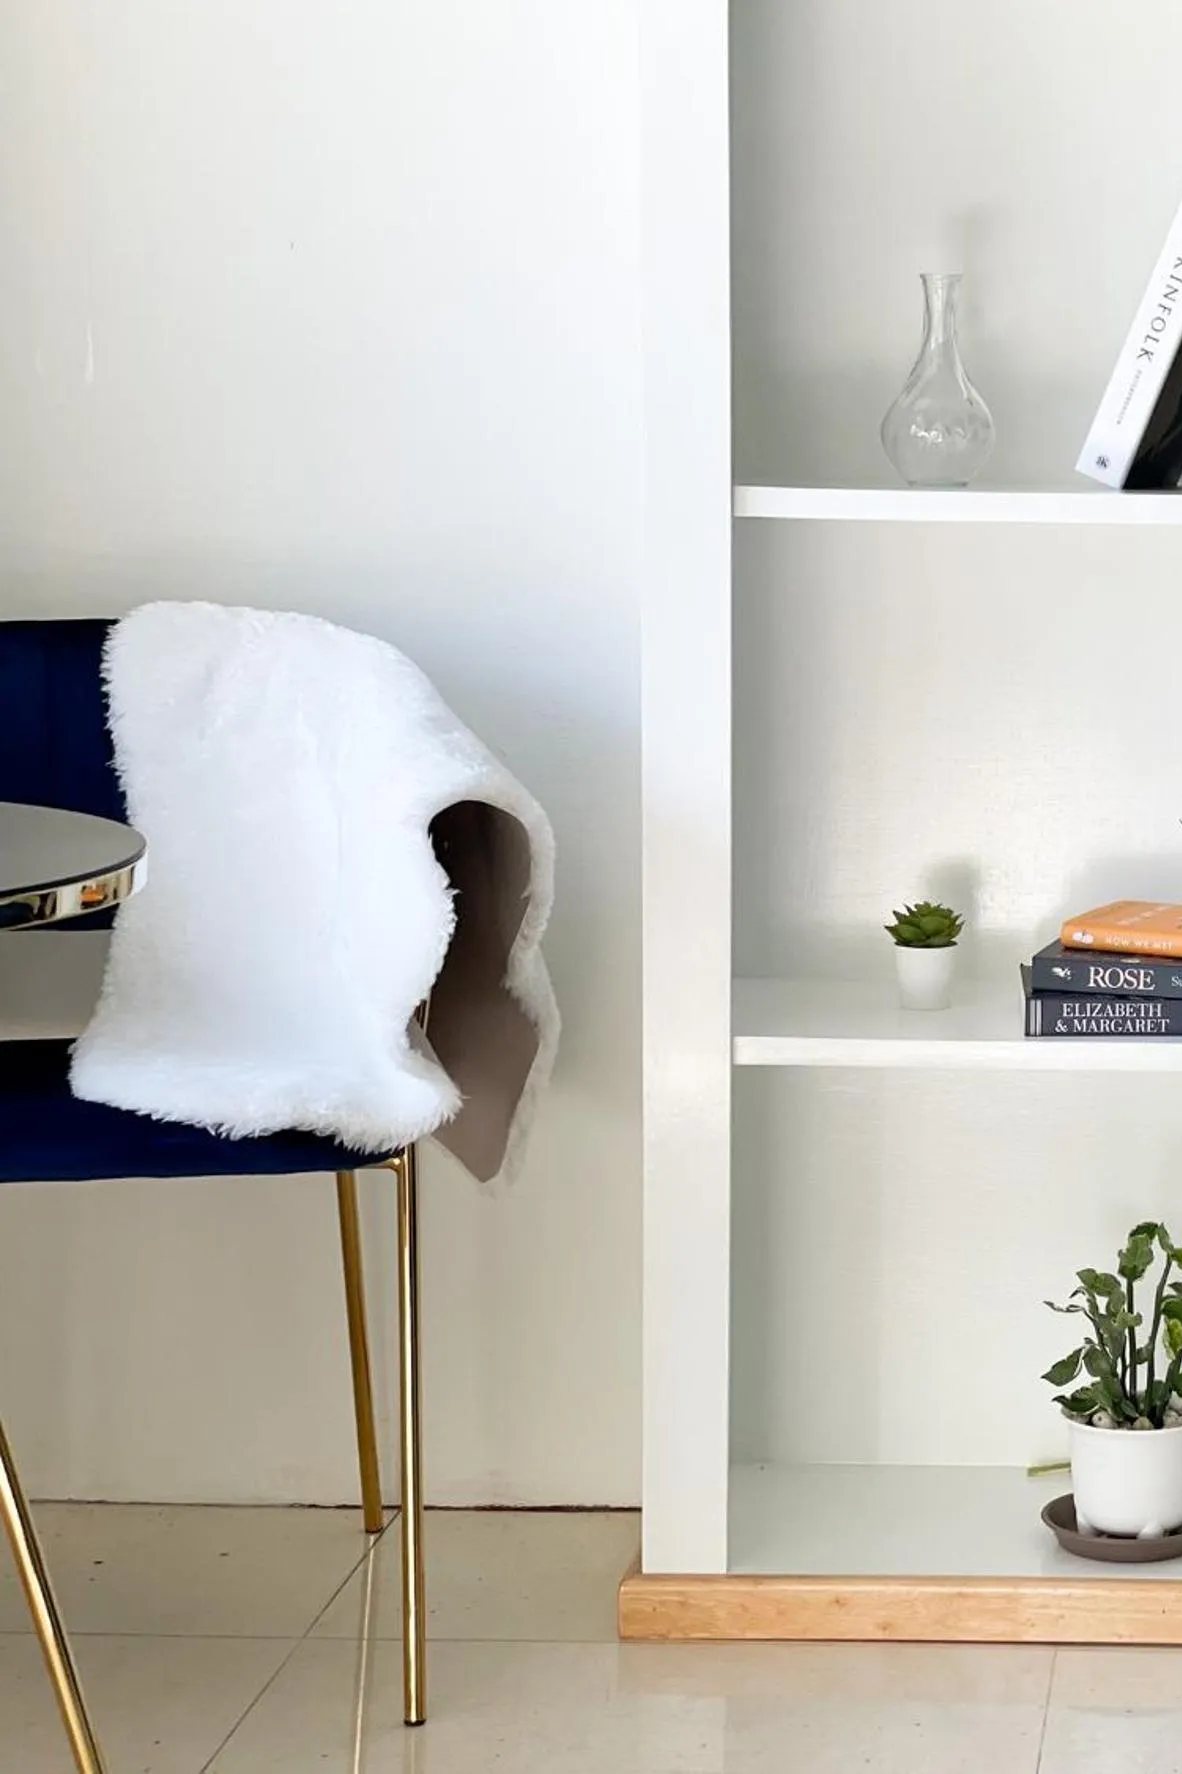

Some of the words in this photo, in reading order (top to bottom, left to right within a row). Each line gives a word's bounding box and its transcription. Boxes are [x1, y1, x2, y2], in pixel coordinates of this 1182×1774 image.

[1087, 966, 1155, 992] ROSE
[1062, 1003, 1162, 1018] ELIZABETH
[1055, 1019, 1067, 1033] &
[1074, 1018, 1169, 1033] MARGARET
